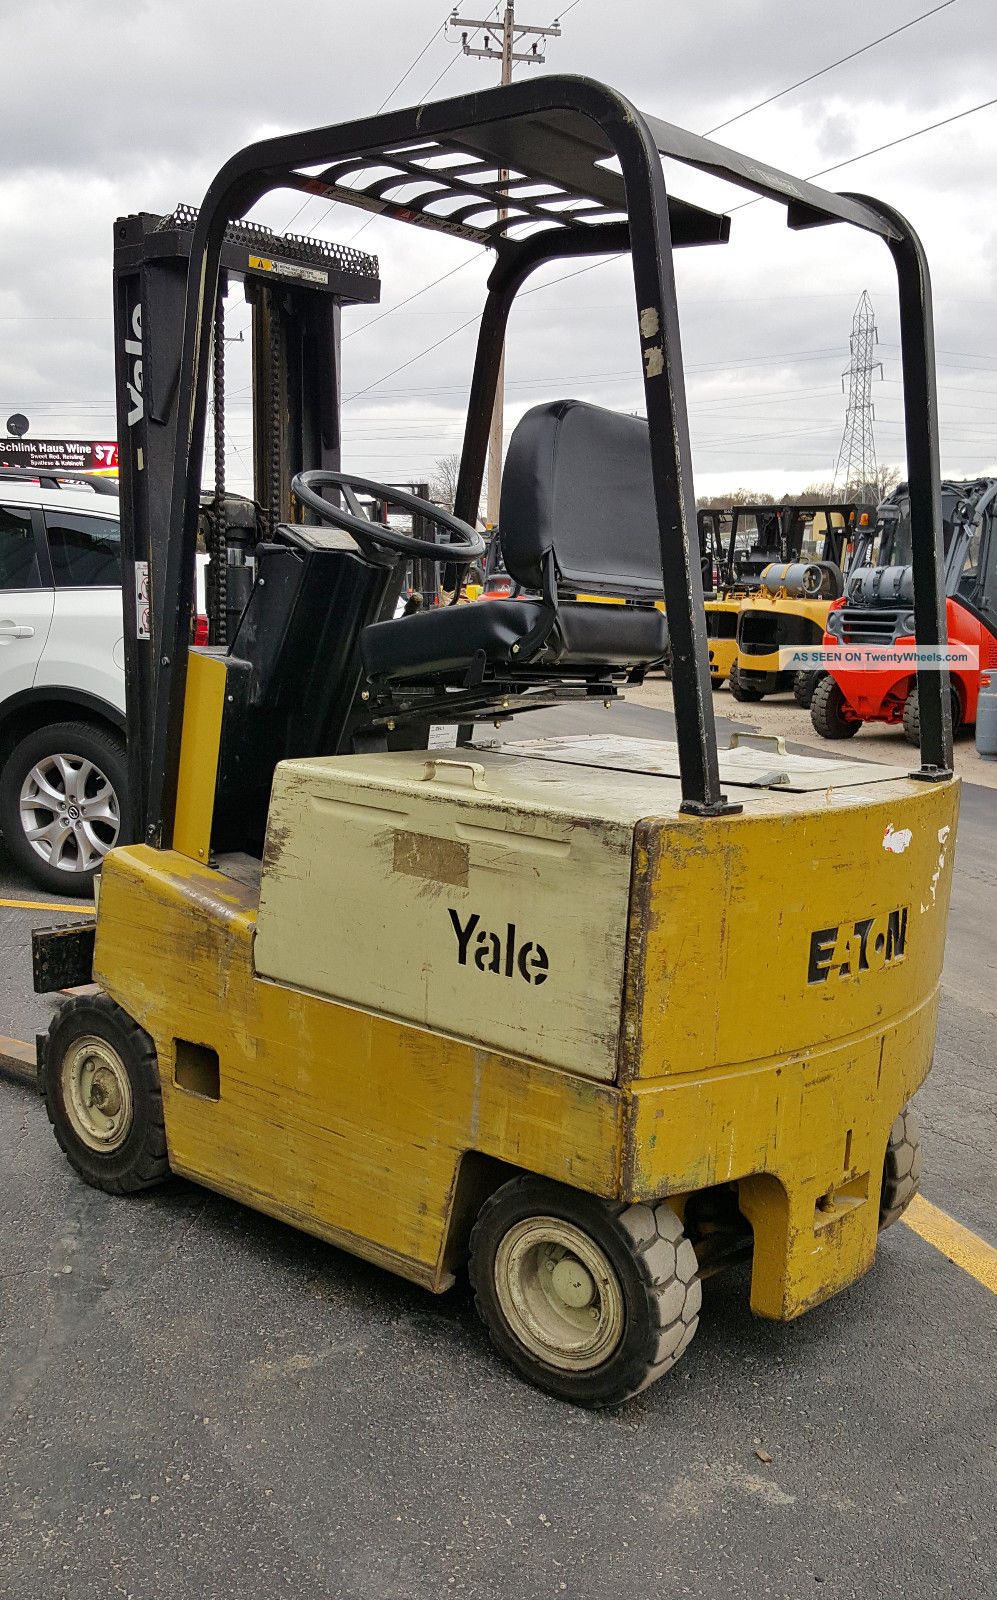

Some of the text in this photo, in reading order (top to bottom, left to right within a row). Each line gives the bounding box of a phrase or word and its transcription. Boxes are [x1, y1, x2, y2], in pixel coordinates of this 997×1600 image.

[0, 442, 91, 454] Schlink Haus Wine
[447, 907, 549, 986] Yale
[807, 906, 908, 985] EATON
